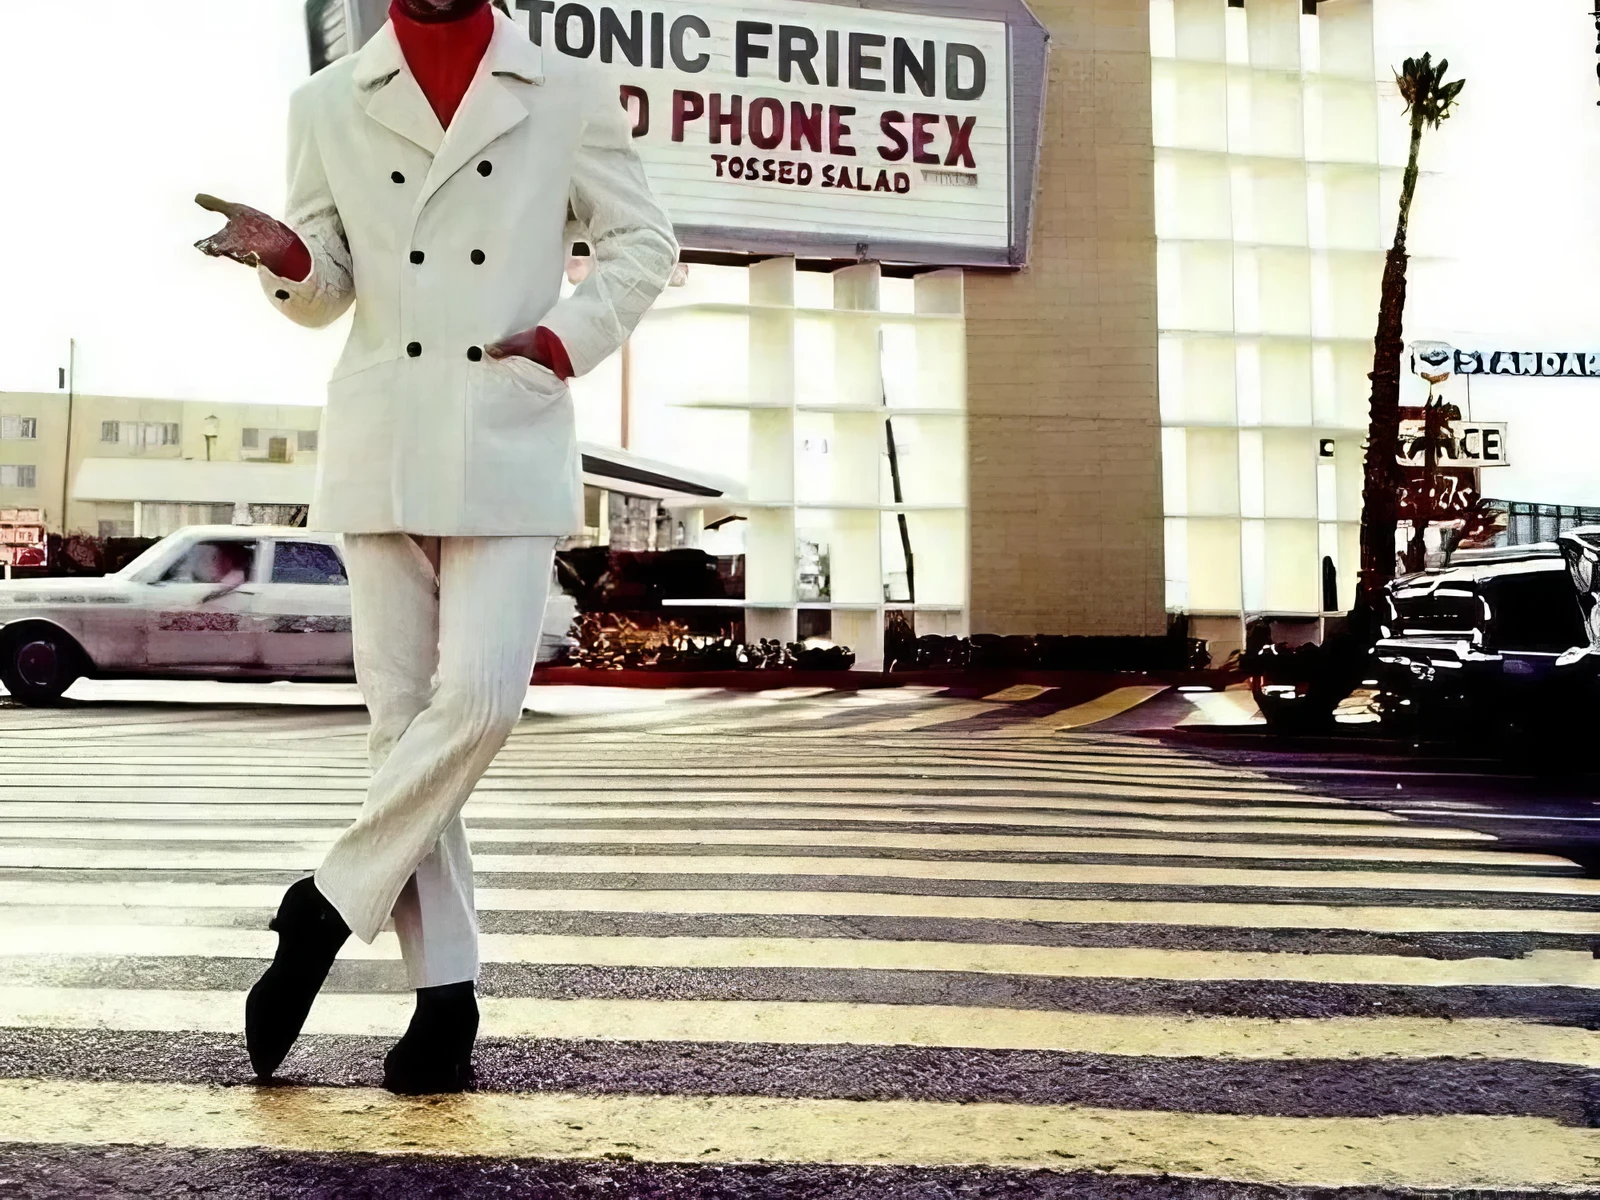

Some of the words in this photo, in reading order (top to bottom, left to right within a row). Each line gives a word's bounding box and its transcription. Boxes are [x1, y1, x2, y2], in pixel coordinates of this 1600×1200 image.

[735, 19, 987, 101] FRIEND
[671, 89, 857, 157] PHONE
[876, 109, 977, 169] SEX
[710, 154, 813, 186] TOSSED
[821, 164, 911, 194] SALAD
